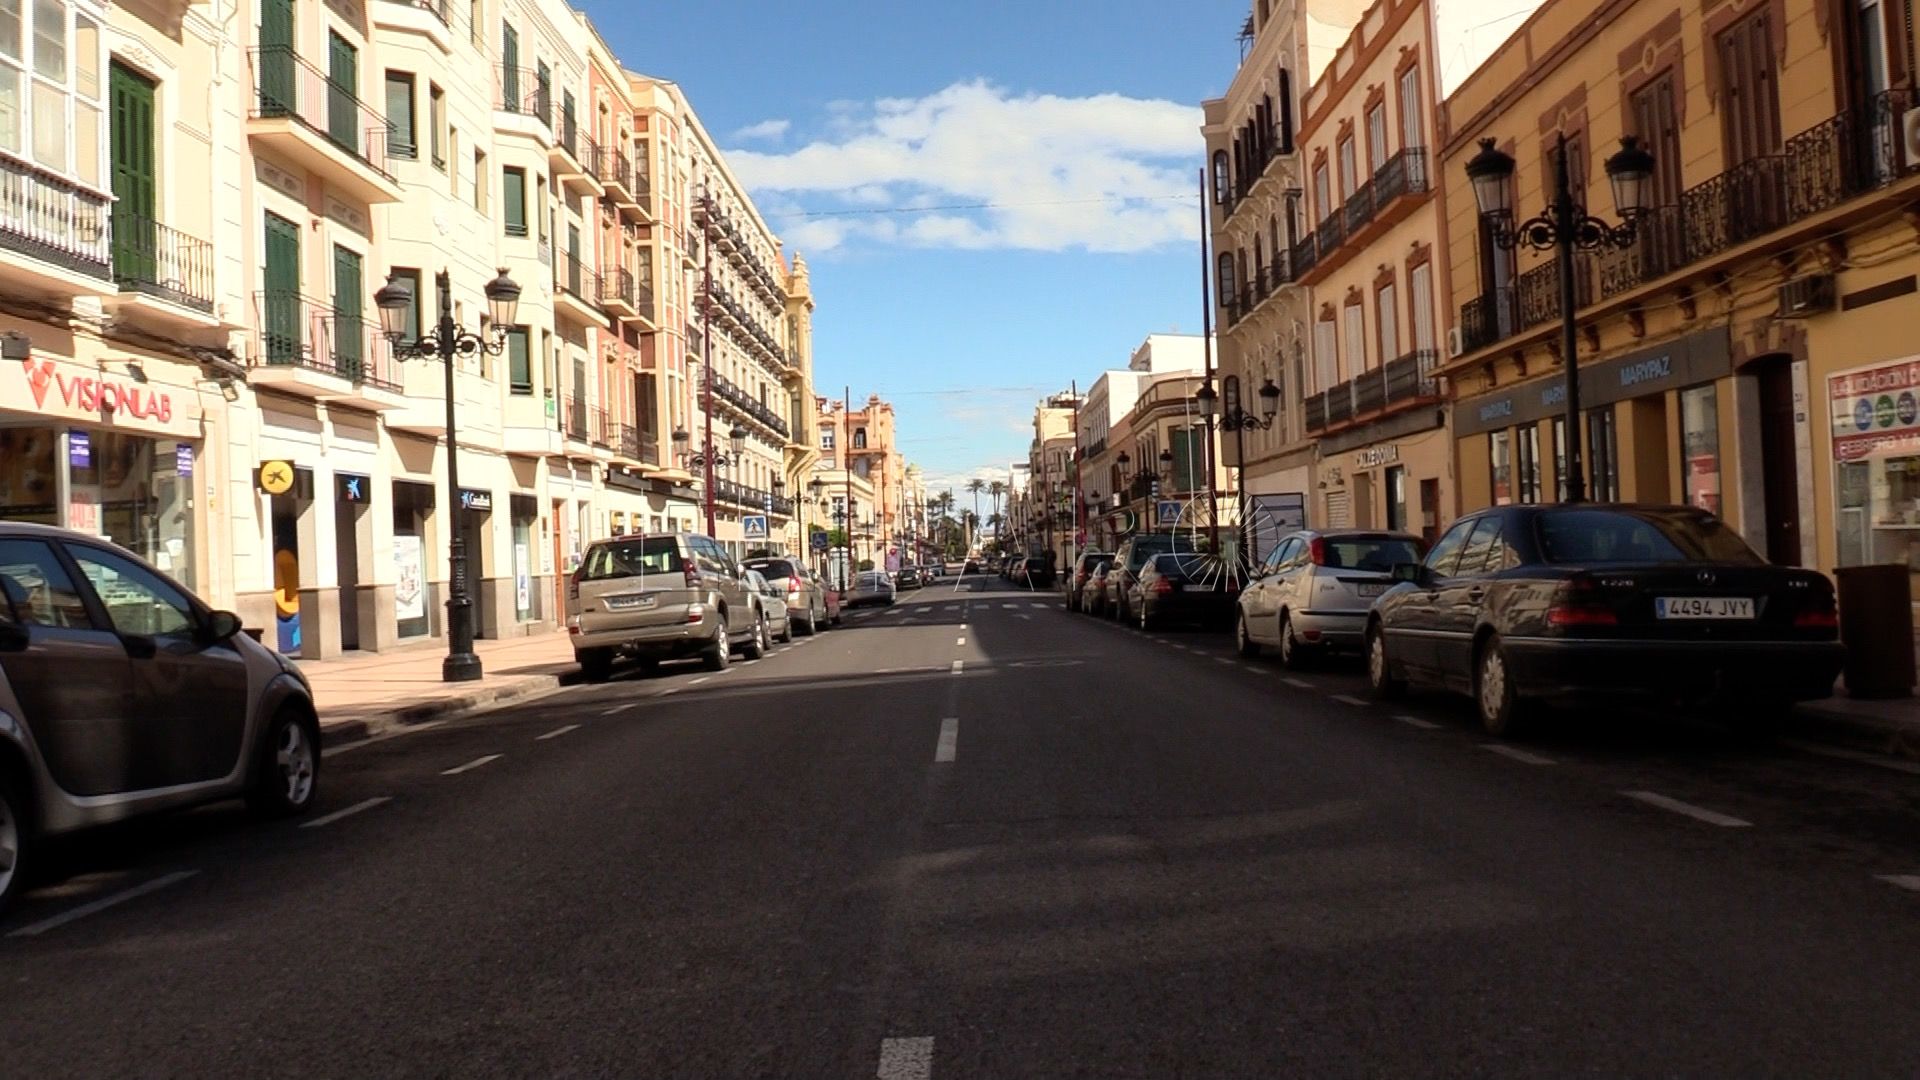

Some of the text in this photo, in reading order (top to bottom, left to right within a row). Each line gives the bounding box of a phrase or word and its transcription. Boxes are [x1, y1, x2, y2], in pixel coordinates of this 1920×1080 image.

[1621, 355, 1670, 387] MARYPAZ
[55, 372, 172, 424] VISIONLAB
[1670, 599, 1749, 616] 4494 JVY
